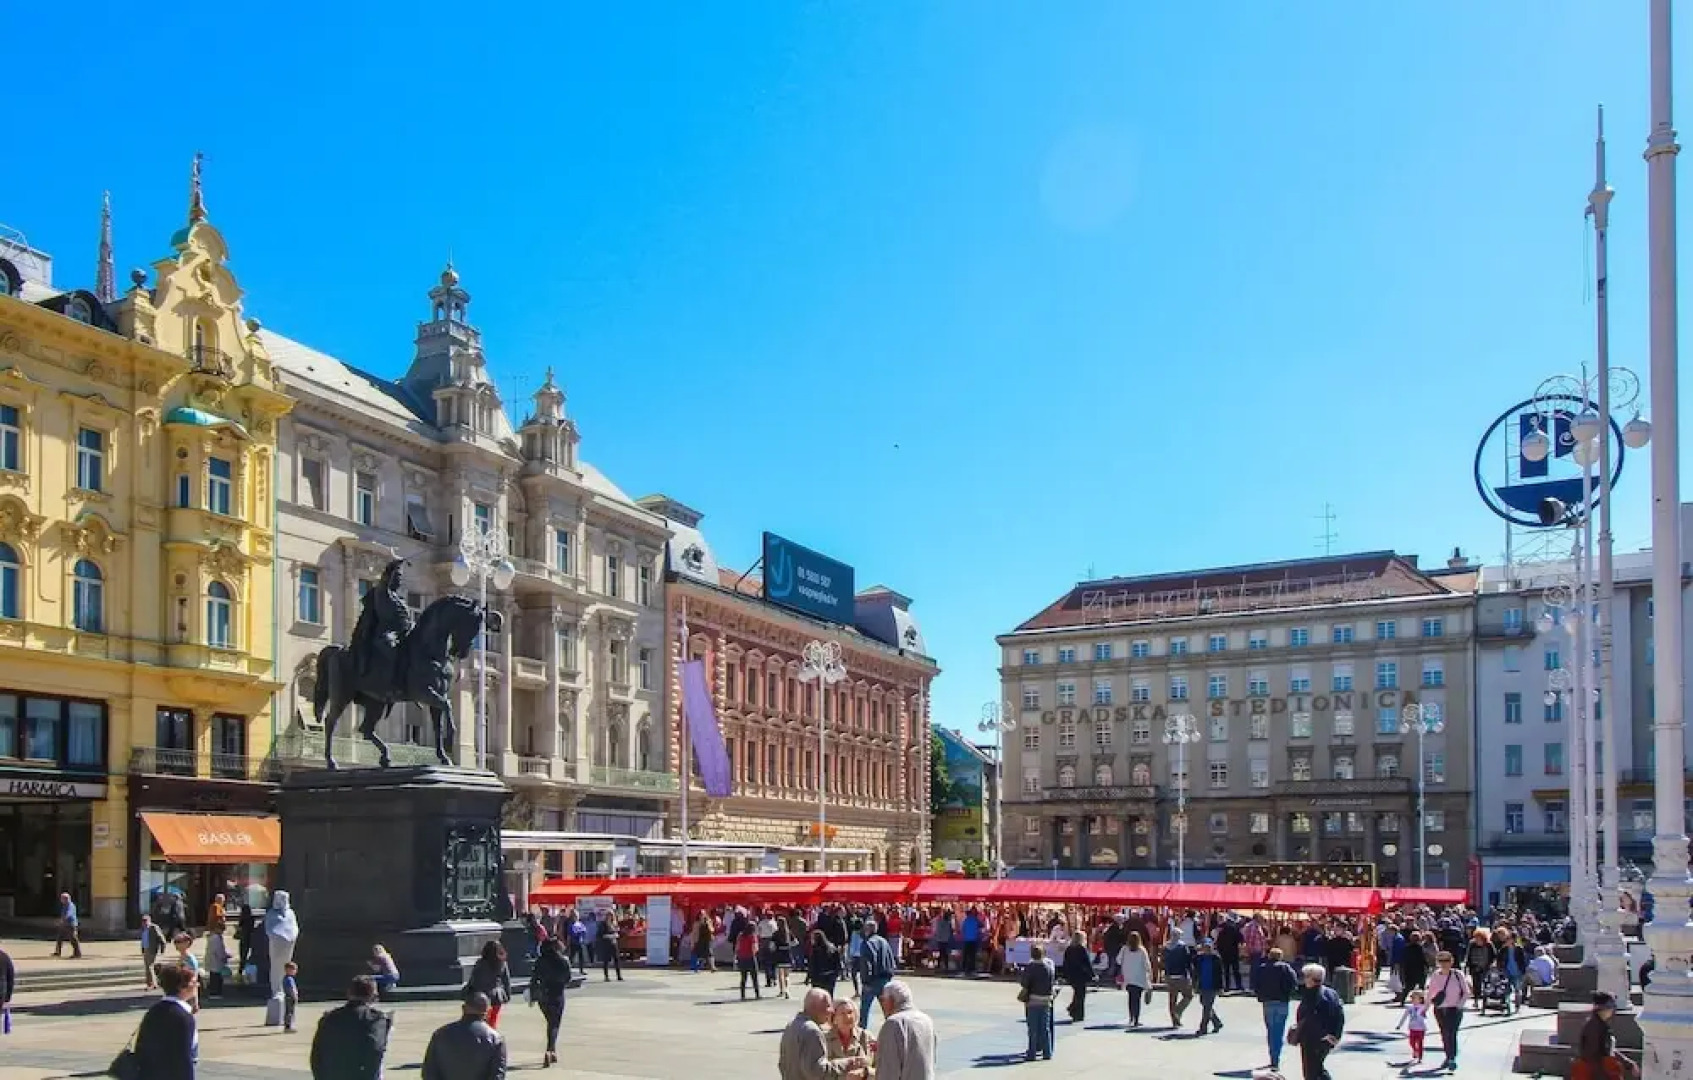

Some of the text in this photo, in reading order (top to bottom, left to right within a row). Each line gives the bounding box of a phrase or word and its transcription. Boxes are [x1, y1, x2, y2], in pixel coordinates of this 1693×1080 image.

[1041, 703, 1167, 725] GRADSKA
[9, 781, 77, 798] HARMICA
[197, 832, 254, 846] BASLER
